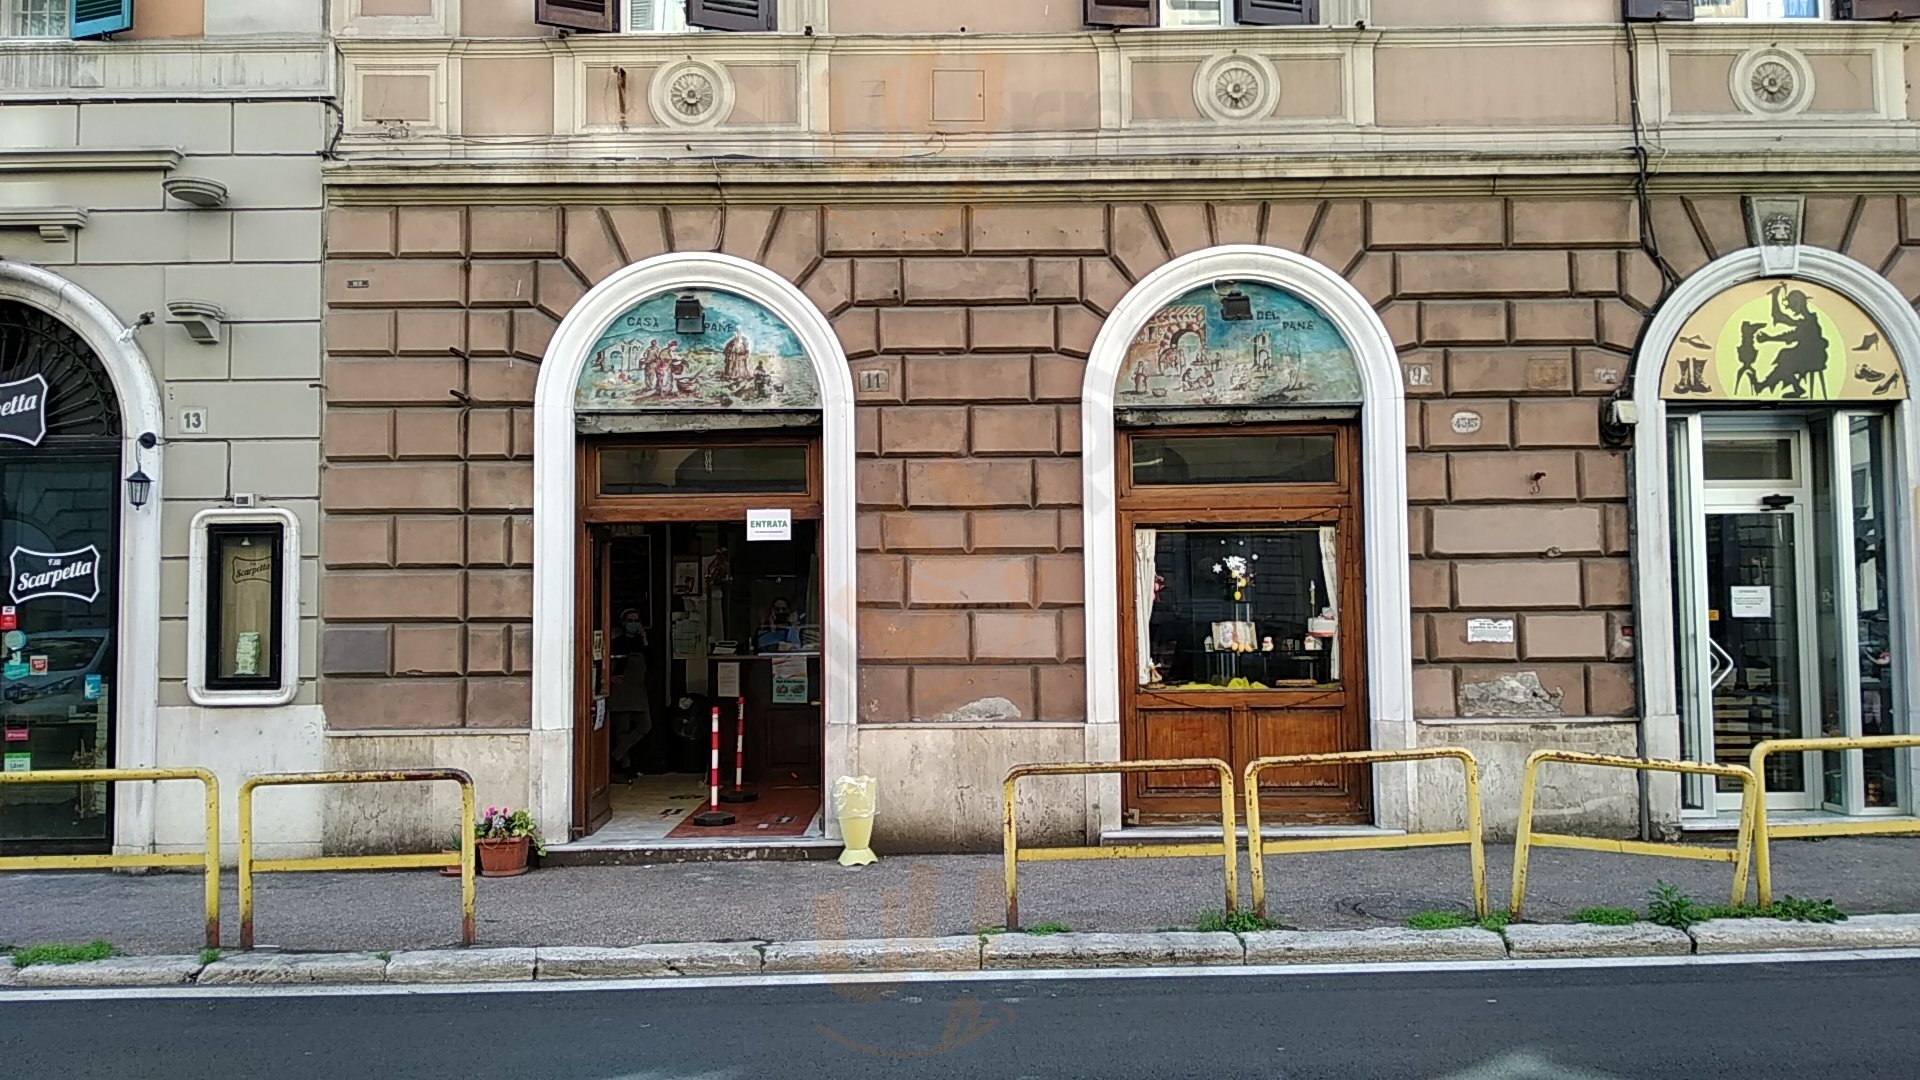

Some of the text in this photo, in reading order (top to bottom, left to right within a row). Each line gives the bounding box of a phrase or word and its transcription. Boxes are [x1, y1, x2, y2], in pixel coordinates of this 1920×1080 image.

[1256, 310, 1281, 321] DEL
[626, 316, 736, 333] CASA PANE
[1281, 320, 1315, 332] PANE
[865, 372, 881, 389] 11
[0, 393, 37, 417] etta
[183, 412, 202, 429] 13
[750, 520, 788, 528] ENTRATA
[17, 560, 93, 591] Scarpetta
[235, 562, 271, 579] Scarpetta
